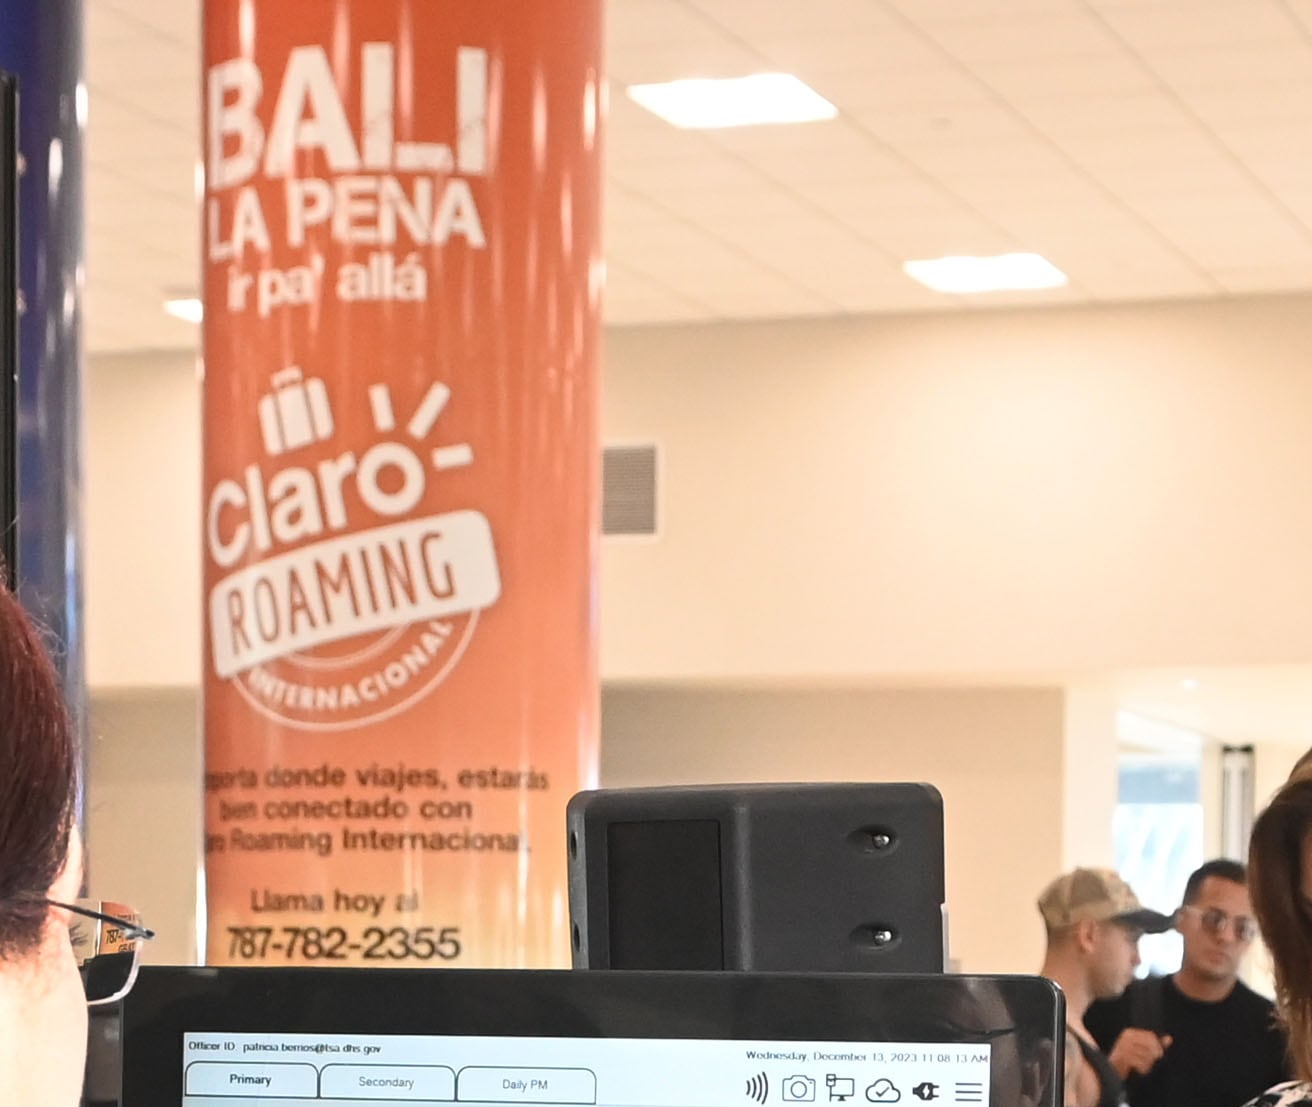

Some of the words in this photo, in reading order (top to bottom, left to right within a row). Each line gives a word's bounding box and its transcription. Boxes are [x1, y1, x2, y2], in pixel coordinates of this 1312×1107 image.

[208, 42, 487, 190] BALI
[209, 186, 271, 262] LA
[207, 442, 425, 568] Claro
[227, 530, 457, 656] ROAMING
[248, 620, 454, 711] INTERNACIONAL
[265, 764, 345, 788] donde
[264, 798, 408, 821] conectado
[419, 801, 472, 820] con
[231, 827, 333, 857] Roaming
[250, 888, 324, 913] Llama
[334, 889, 386, 916] hoy
[227, 926, 462, 961] 787-782-2355
[813, 1051, 867, 1062] December
[890, 1053, 918, 1063] 2023
[229, 1073, 272, 1086] Primary
[358, 1076, 415, 1090] Secondary
[502, 1079, 527, 1093] Daily
[530, 1080, 548, 1090] PM
